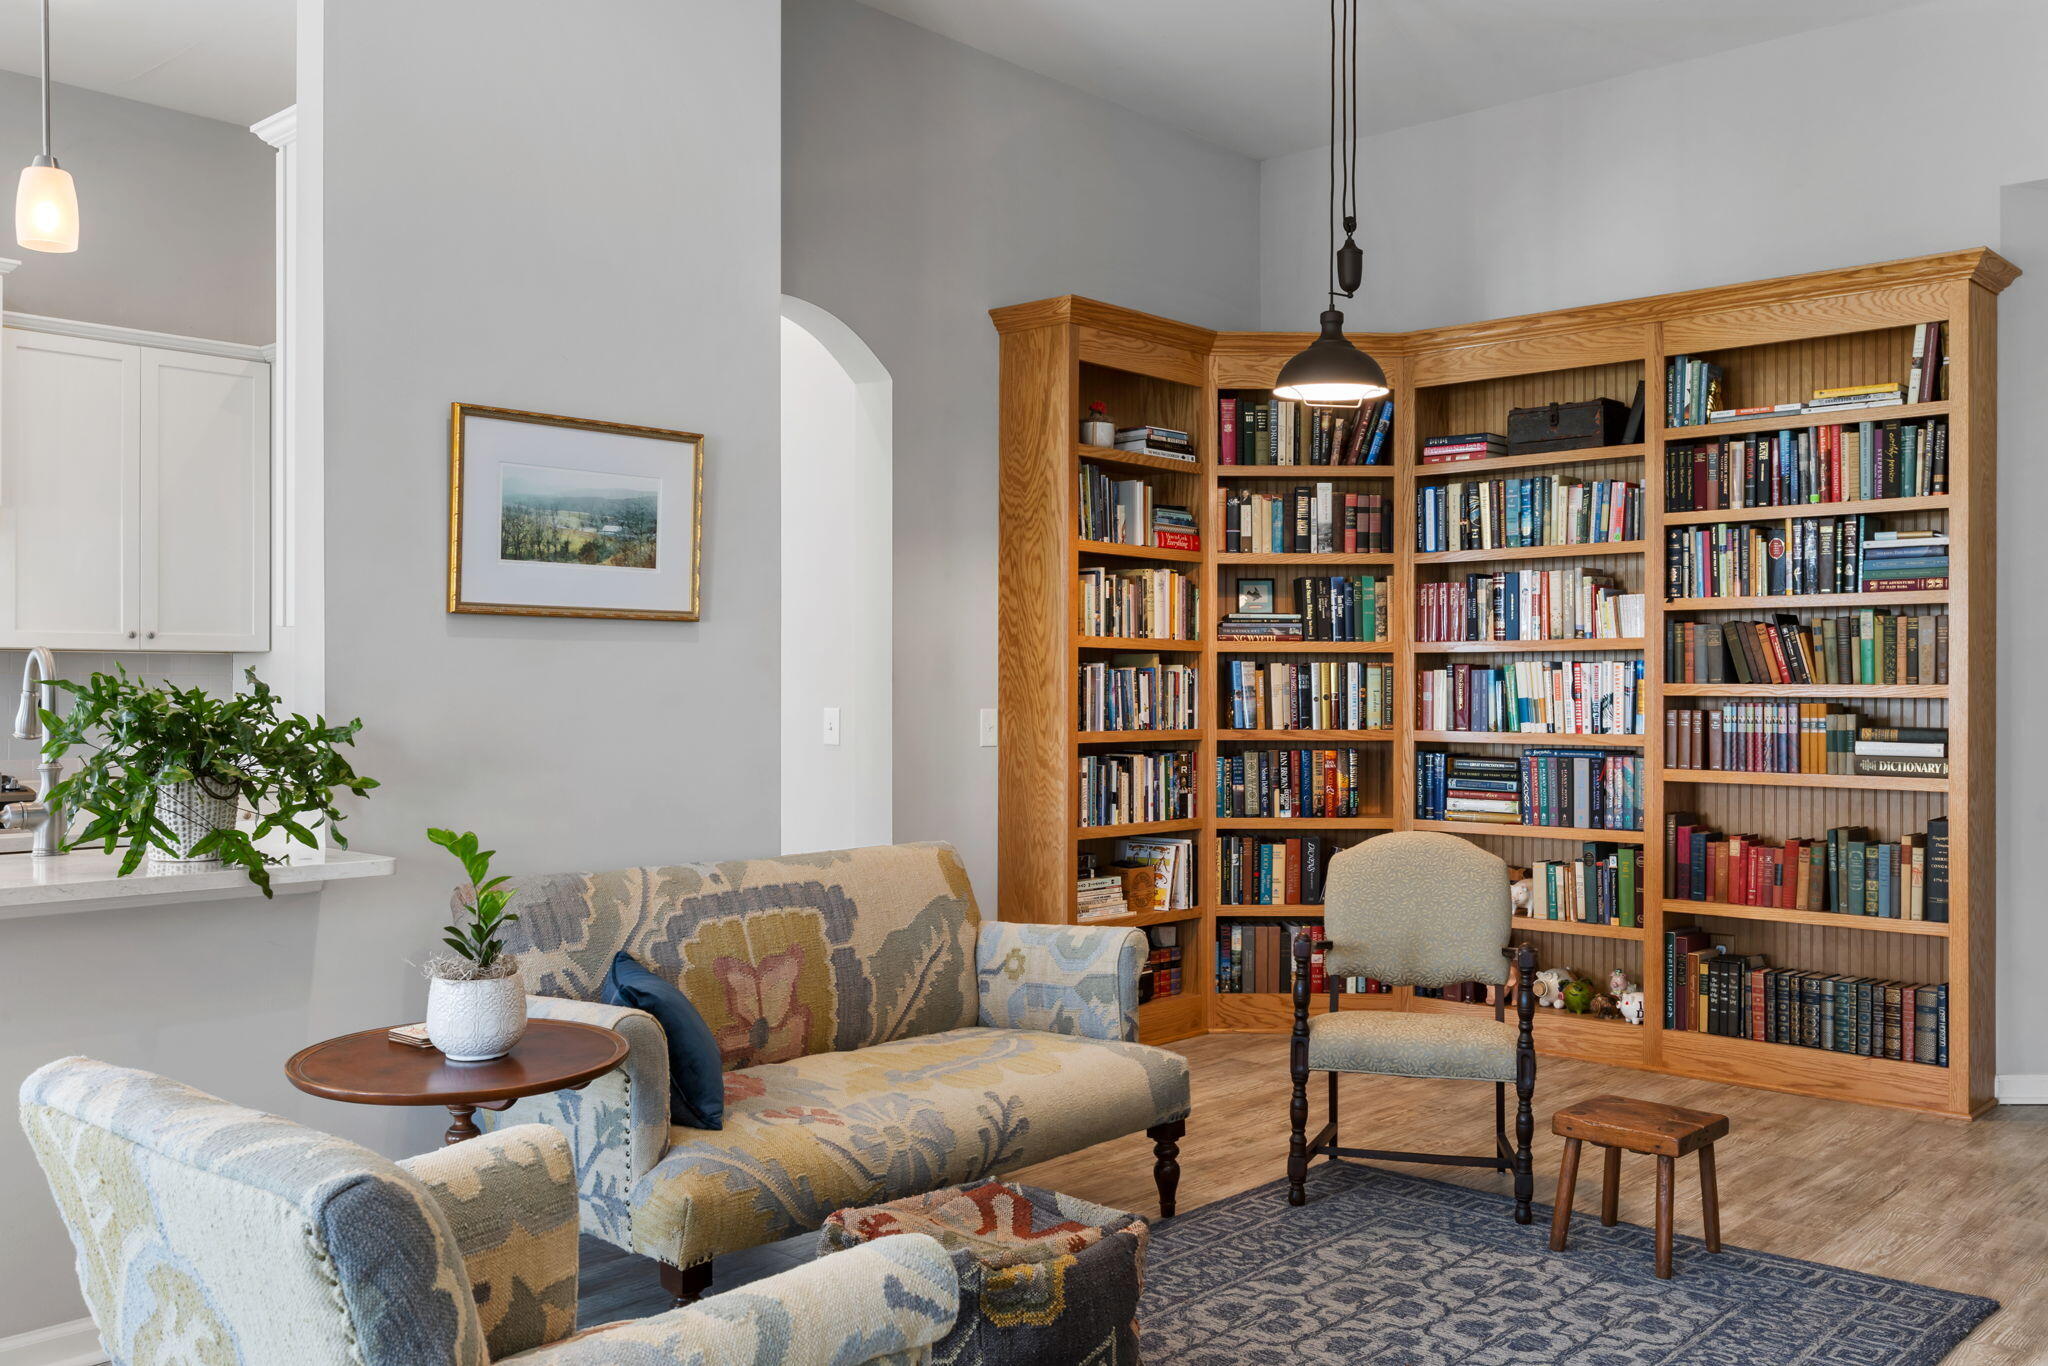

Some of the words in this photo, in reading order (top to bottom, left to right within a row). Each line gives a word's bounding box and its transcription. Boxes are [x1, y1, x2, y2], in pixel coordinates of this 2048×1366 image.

[1270, 407, 1278, 422] THE
[1270, 425, 1278, 457] DRUIDS
[1746, 448, 1754, 480] DRACULA
[1336, 604, 1344, 618] Clancy
[1247, 759, 1257, 780] TOM
[1280, 752, 1288, 766] DAN
[1350, 753, 1358, 765] DAN
[1879, 761, 1942, 774] DICTIONARY
[1280, 767, 1288, 789] BROWN
[1350, 766, 1358, 788] BROWN
[1247, 783, 1258, 810] WOLFE
[1326, 785, 1334, 795] &
[1307, 842, 1315, 873] DICKENS
